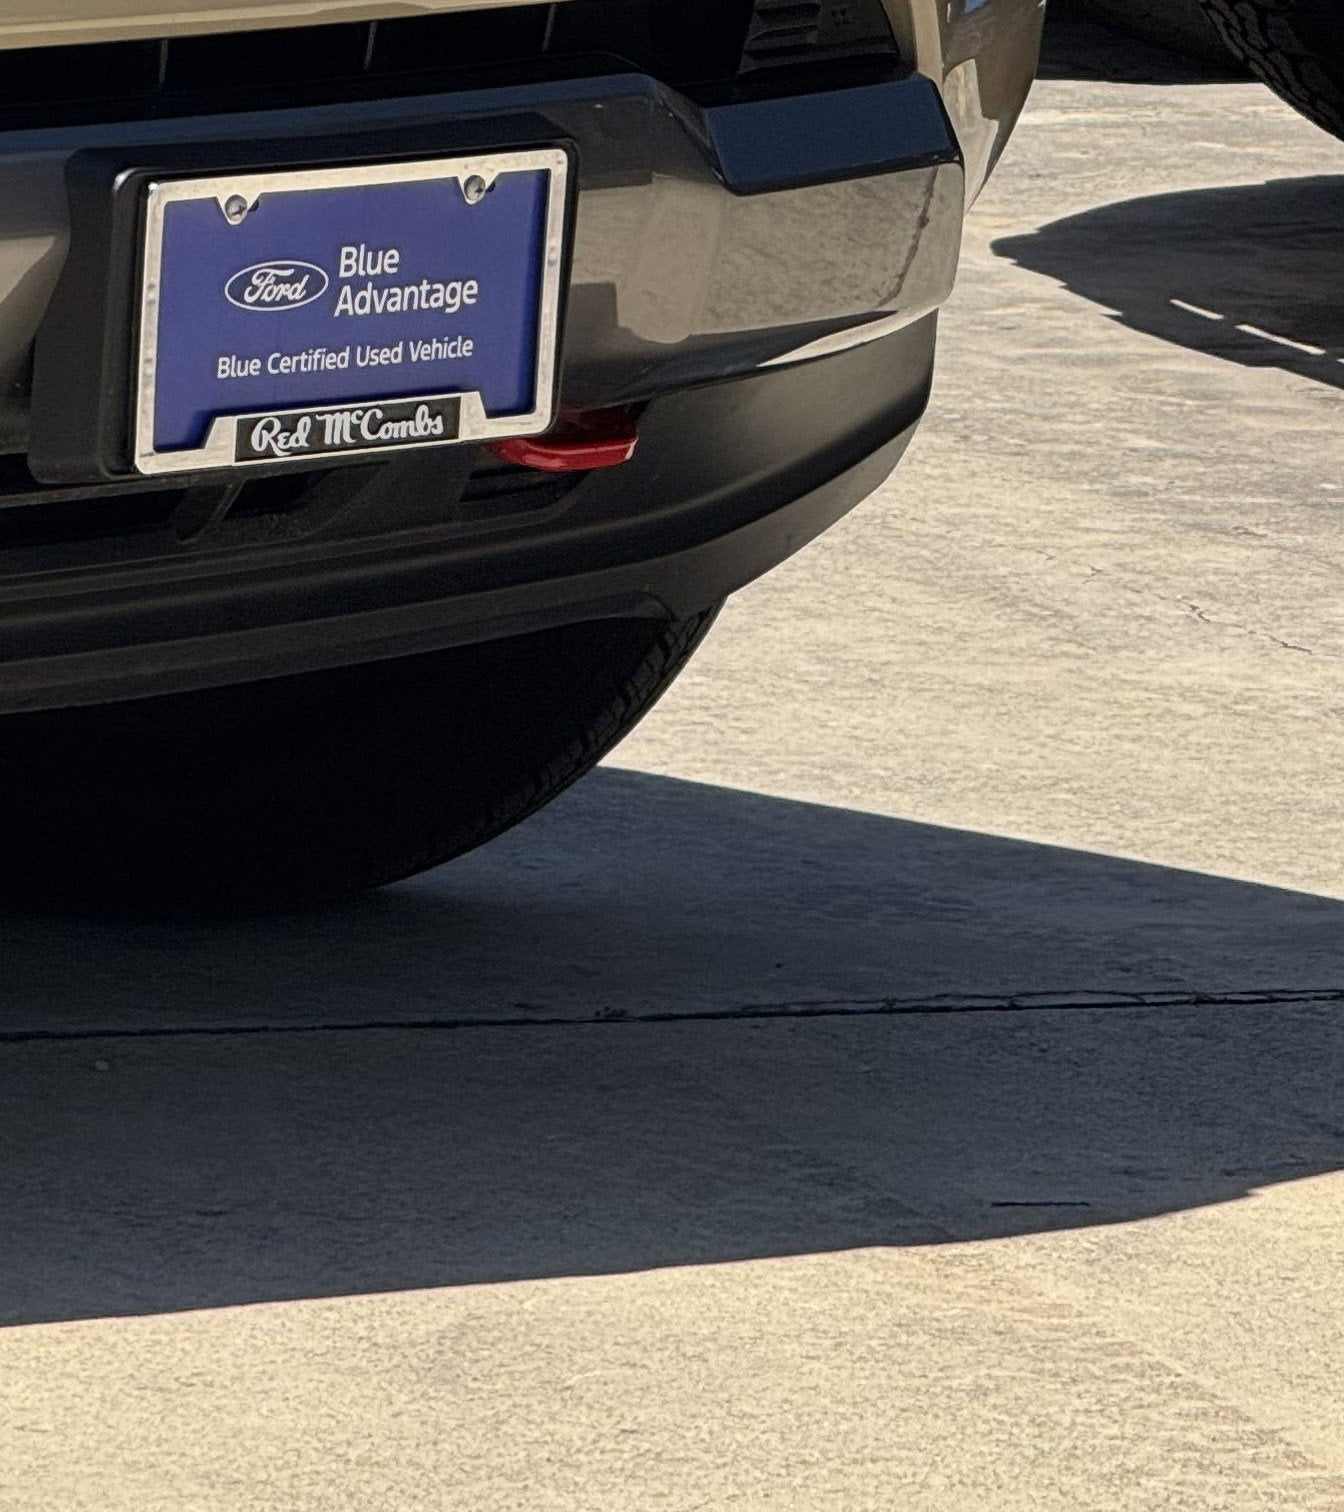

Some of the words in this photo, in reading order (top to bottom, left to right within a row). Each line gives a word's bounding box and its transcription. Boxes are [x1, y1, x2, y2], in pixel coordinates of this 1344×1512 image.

[338, 243, 400, 277] Blue
[243, 268, 310, 303] Ford
[333, 279, 479, 317] Advantage
[217, 355, 261, 379] Blue
[267, 346, 350, 374] Certified
[356, 341, 403, 367] Used
[409, 335, 474, 362] Vehicle
[251, 416, 312, 457] Red
[315, 404, 444, 445] McCombs
